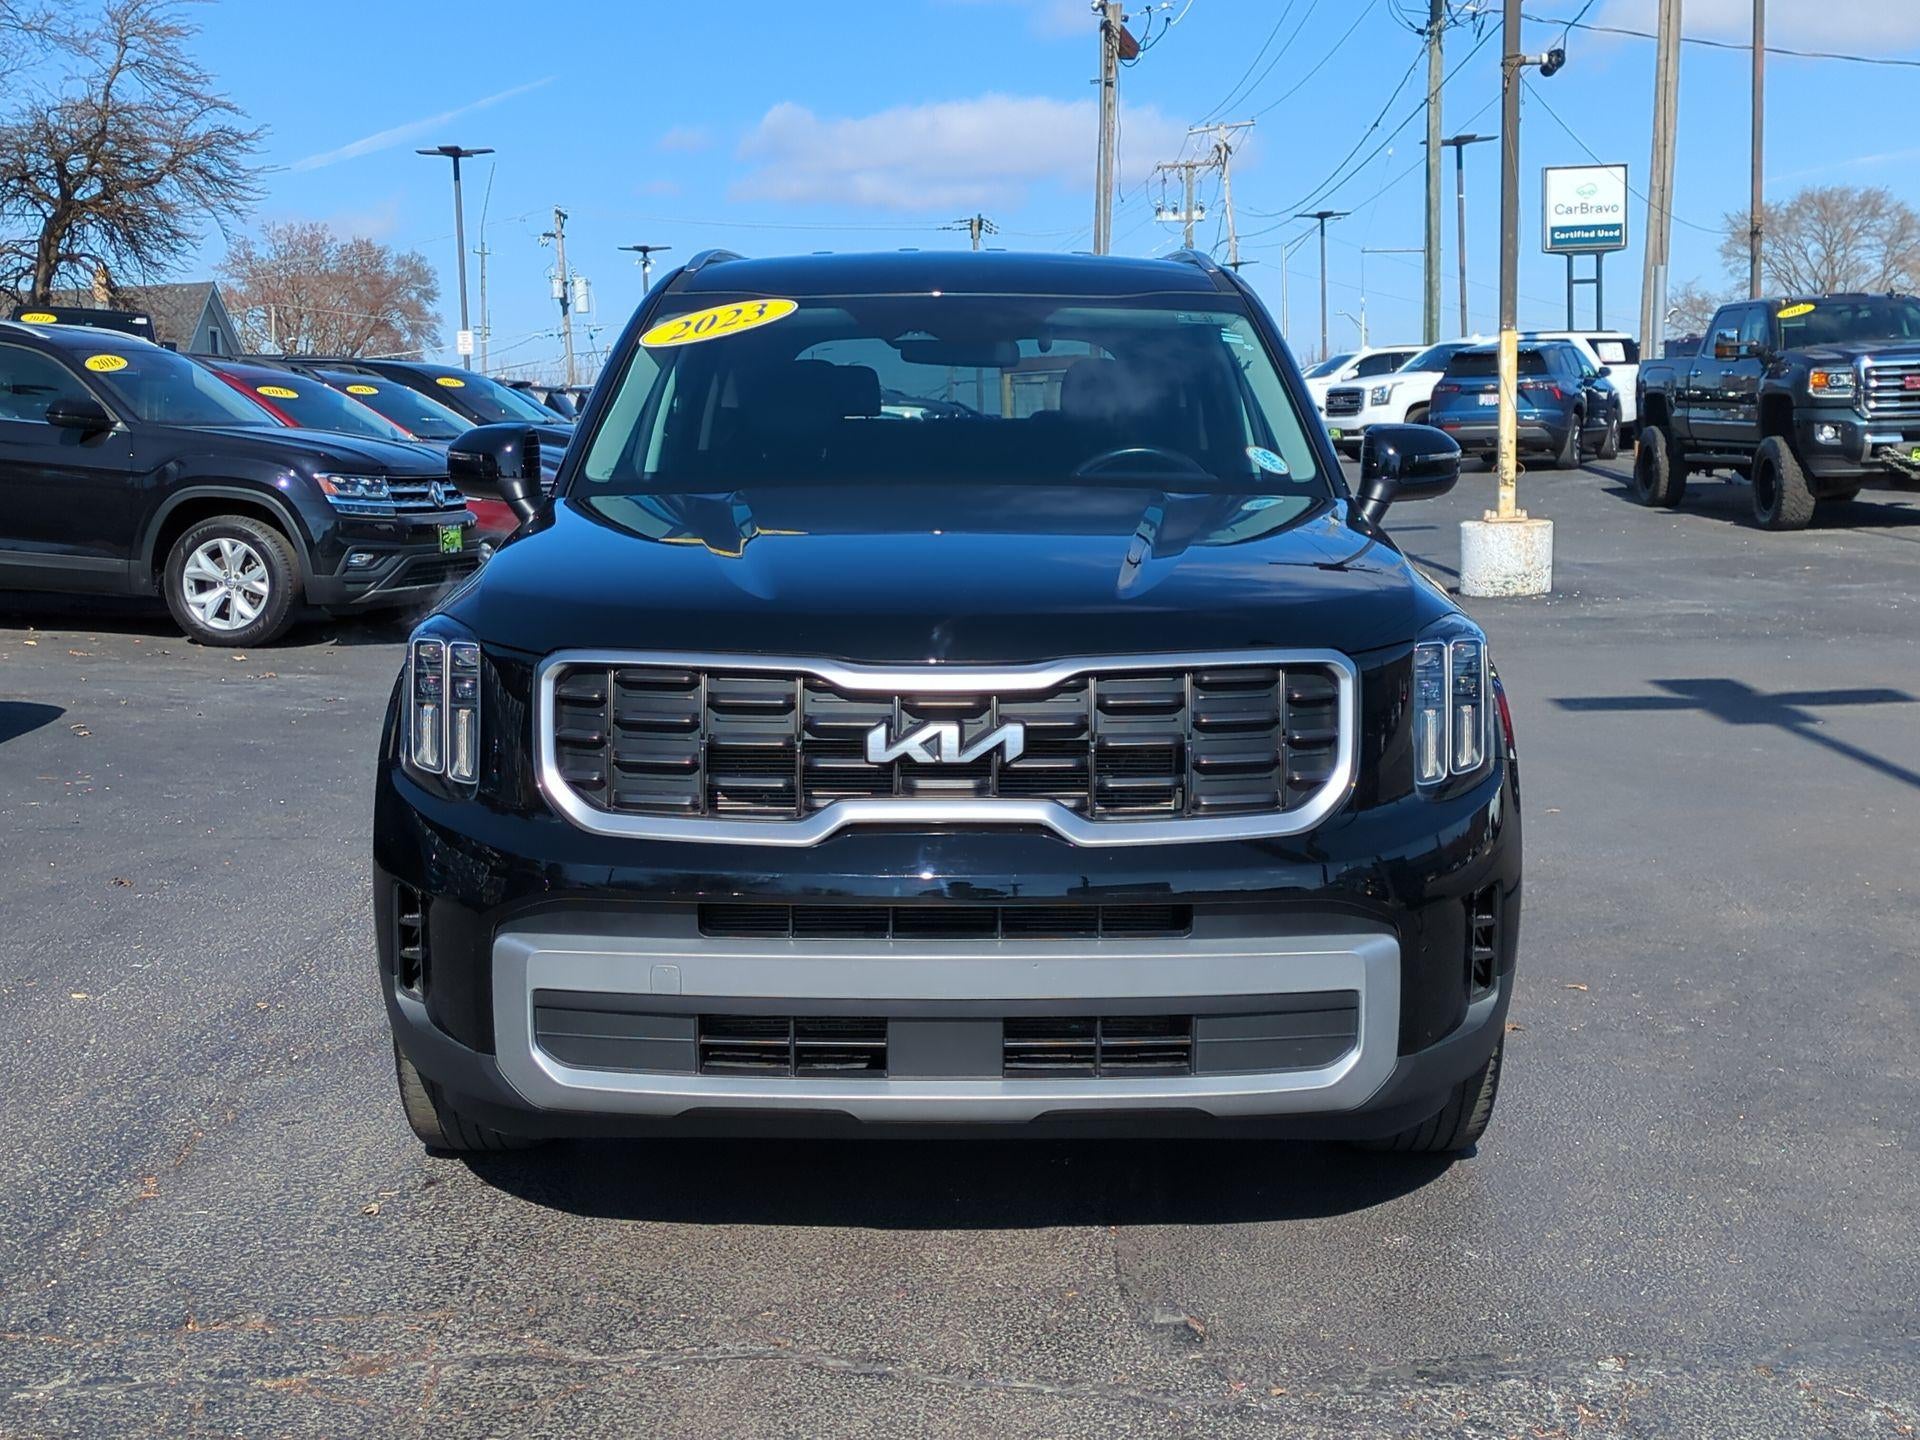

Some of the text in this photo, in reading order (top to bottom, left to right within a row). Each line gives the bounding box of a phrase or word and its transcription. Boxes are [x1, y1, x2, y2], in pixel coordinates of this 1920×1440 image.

[1554, 202, 1619, 215] CarBravo
[1554, 229, 1620, 239] Certified Used
[667, 302, 768, 342] 2023
[93, 357, 121, 370] 2018
[867, 723, 1024, 763] KIA
